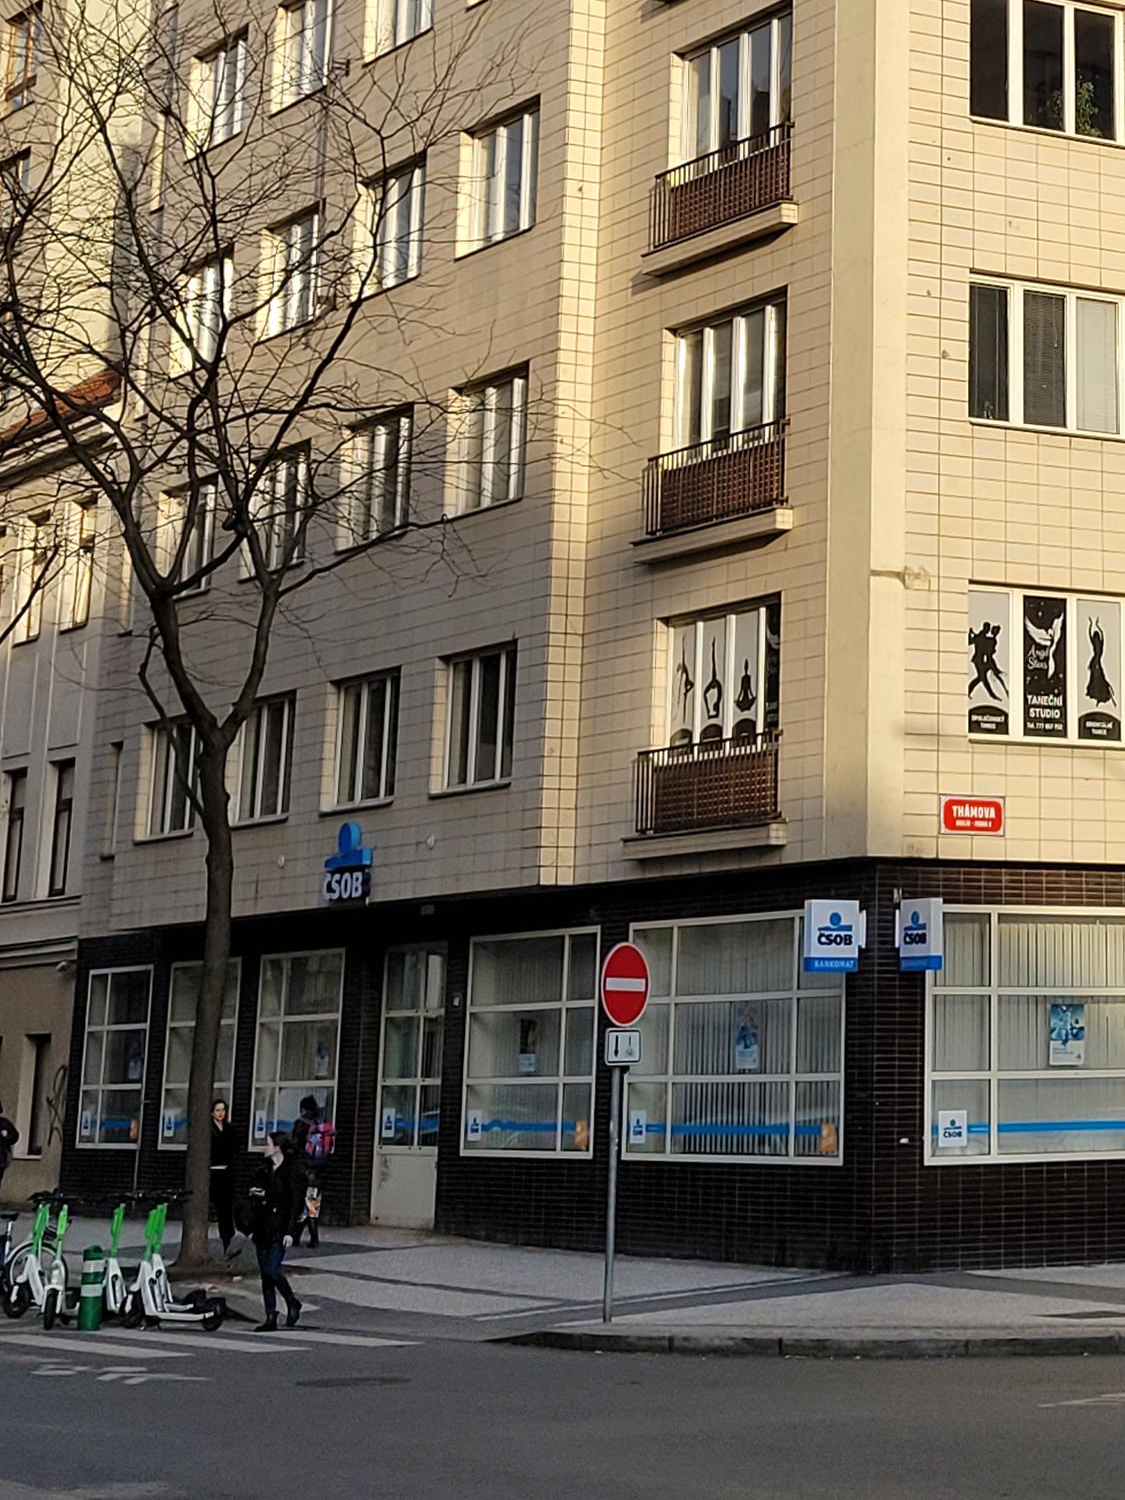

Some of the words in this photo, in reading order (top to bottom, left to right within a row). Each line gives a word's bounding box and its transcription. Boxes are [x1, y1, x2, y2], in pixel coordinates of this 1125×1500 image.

[1026, 694, 1063, 707] TANEČNÍ
[1029, 708, 1061, 719] STUDIO
[952, 804, 996, 819] THÁMOVA
[817, 932, 853, 946] ČSOB
[903, 932, 927, 946] ČSOB
[943, 1130, 963, 1138] ČSOB
